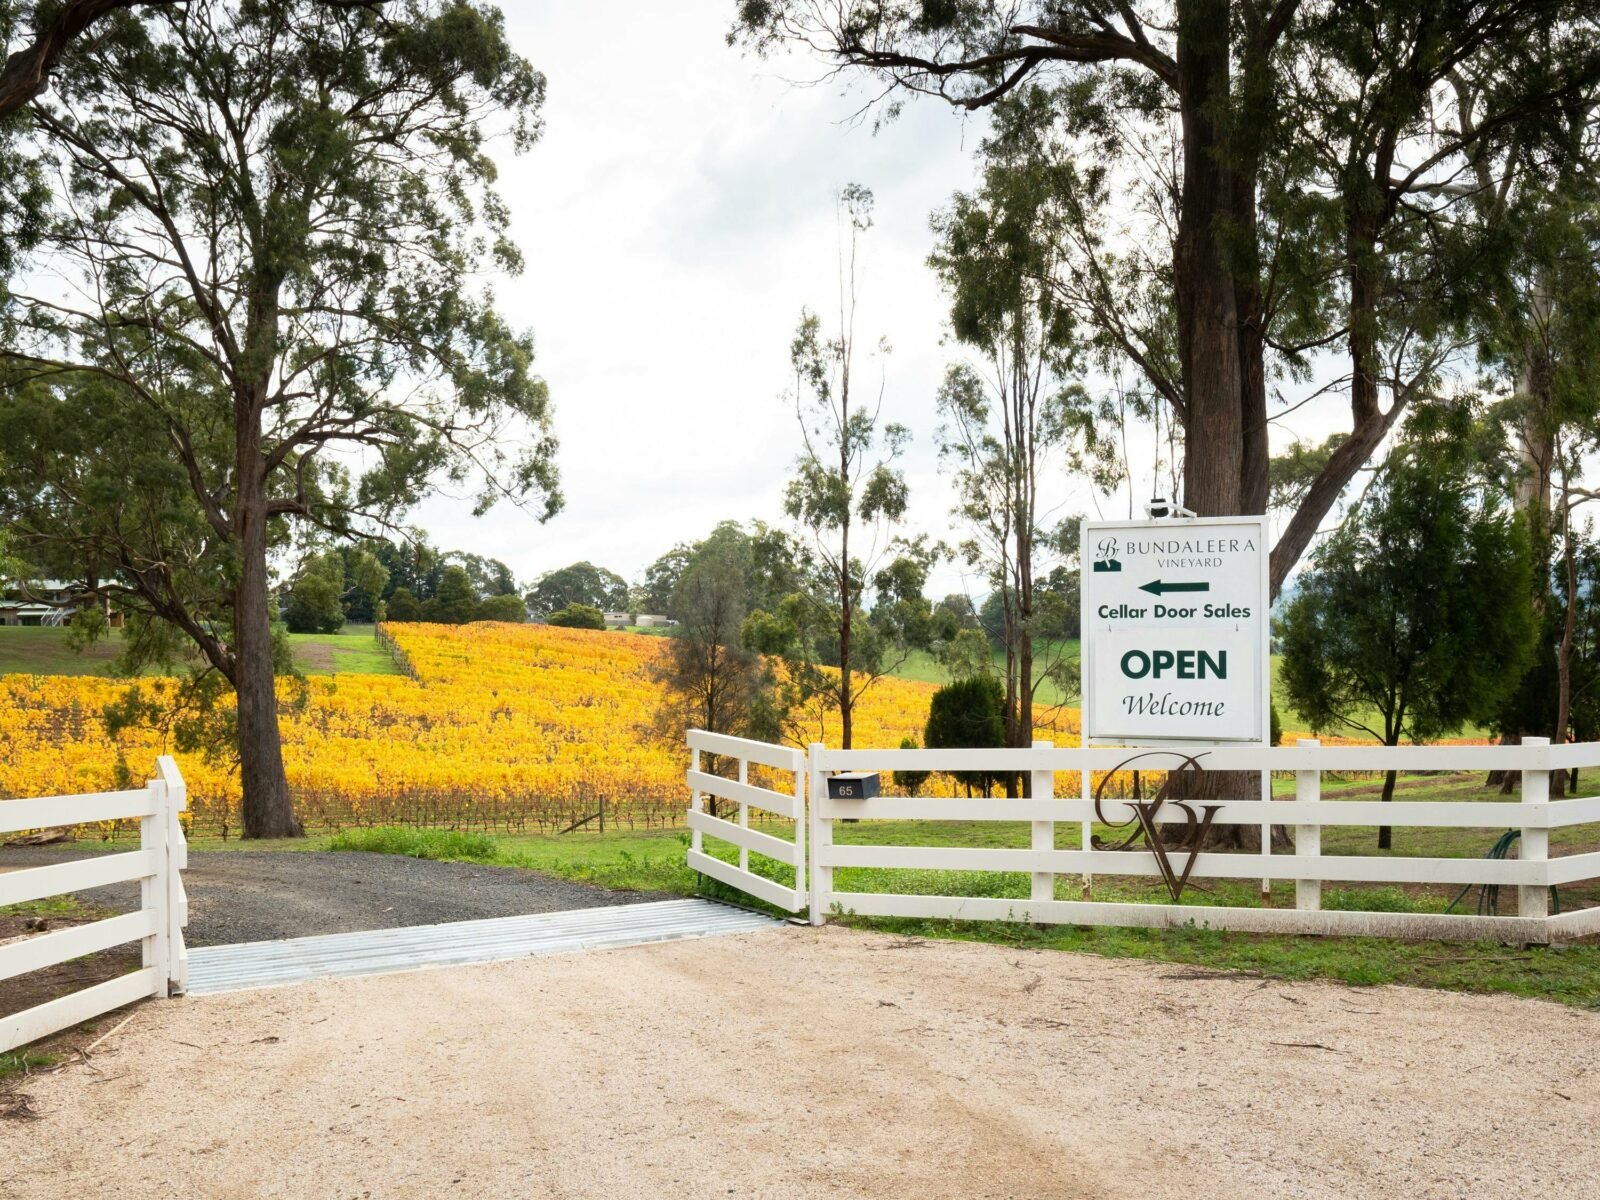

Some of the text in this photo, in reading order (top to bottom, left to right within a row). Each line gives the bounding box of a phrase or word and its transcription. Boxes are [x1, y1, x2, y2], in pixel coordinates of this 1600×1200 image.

[1127, 539, 1255, 555] BUNDALEERA
[1157, 557, 1223, 568] VINEYARD
[1098, 603, 1251, 619] Cellar Door Sales
[1120, 650, 1227, 679] OPEN
[1122, 692, 1225, 717] Welcome
[839, 786, 853, 796] 65
